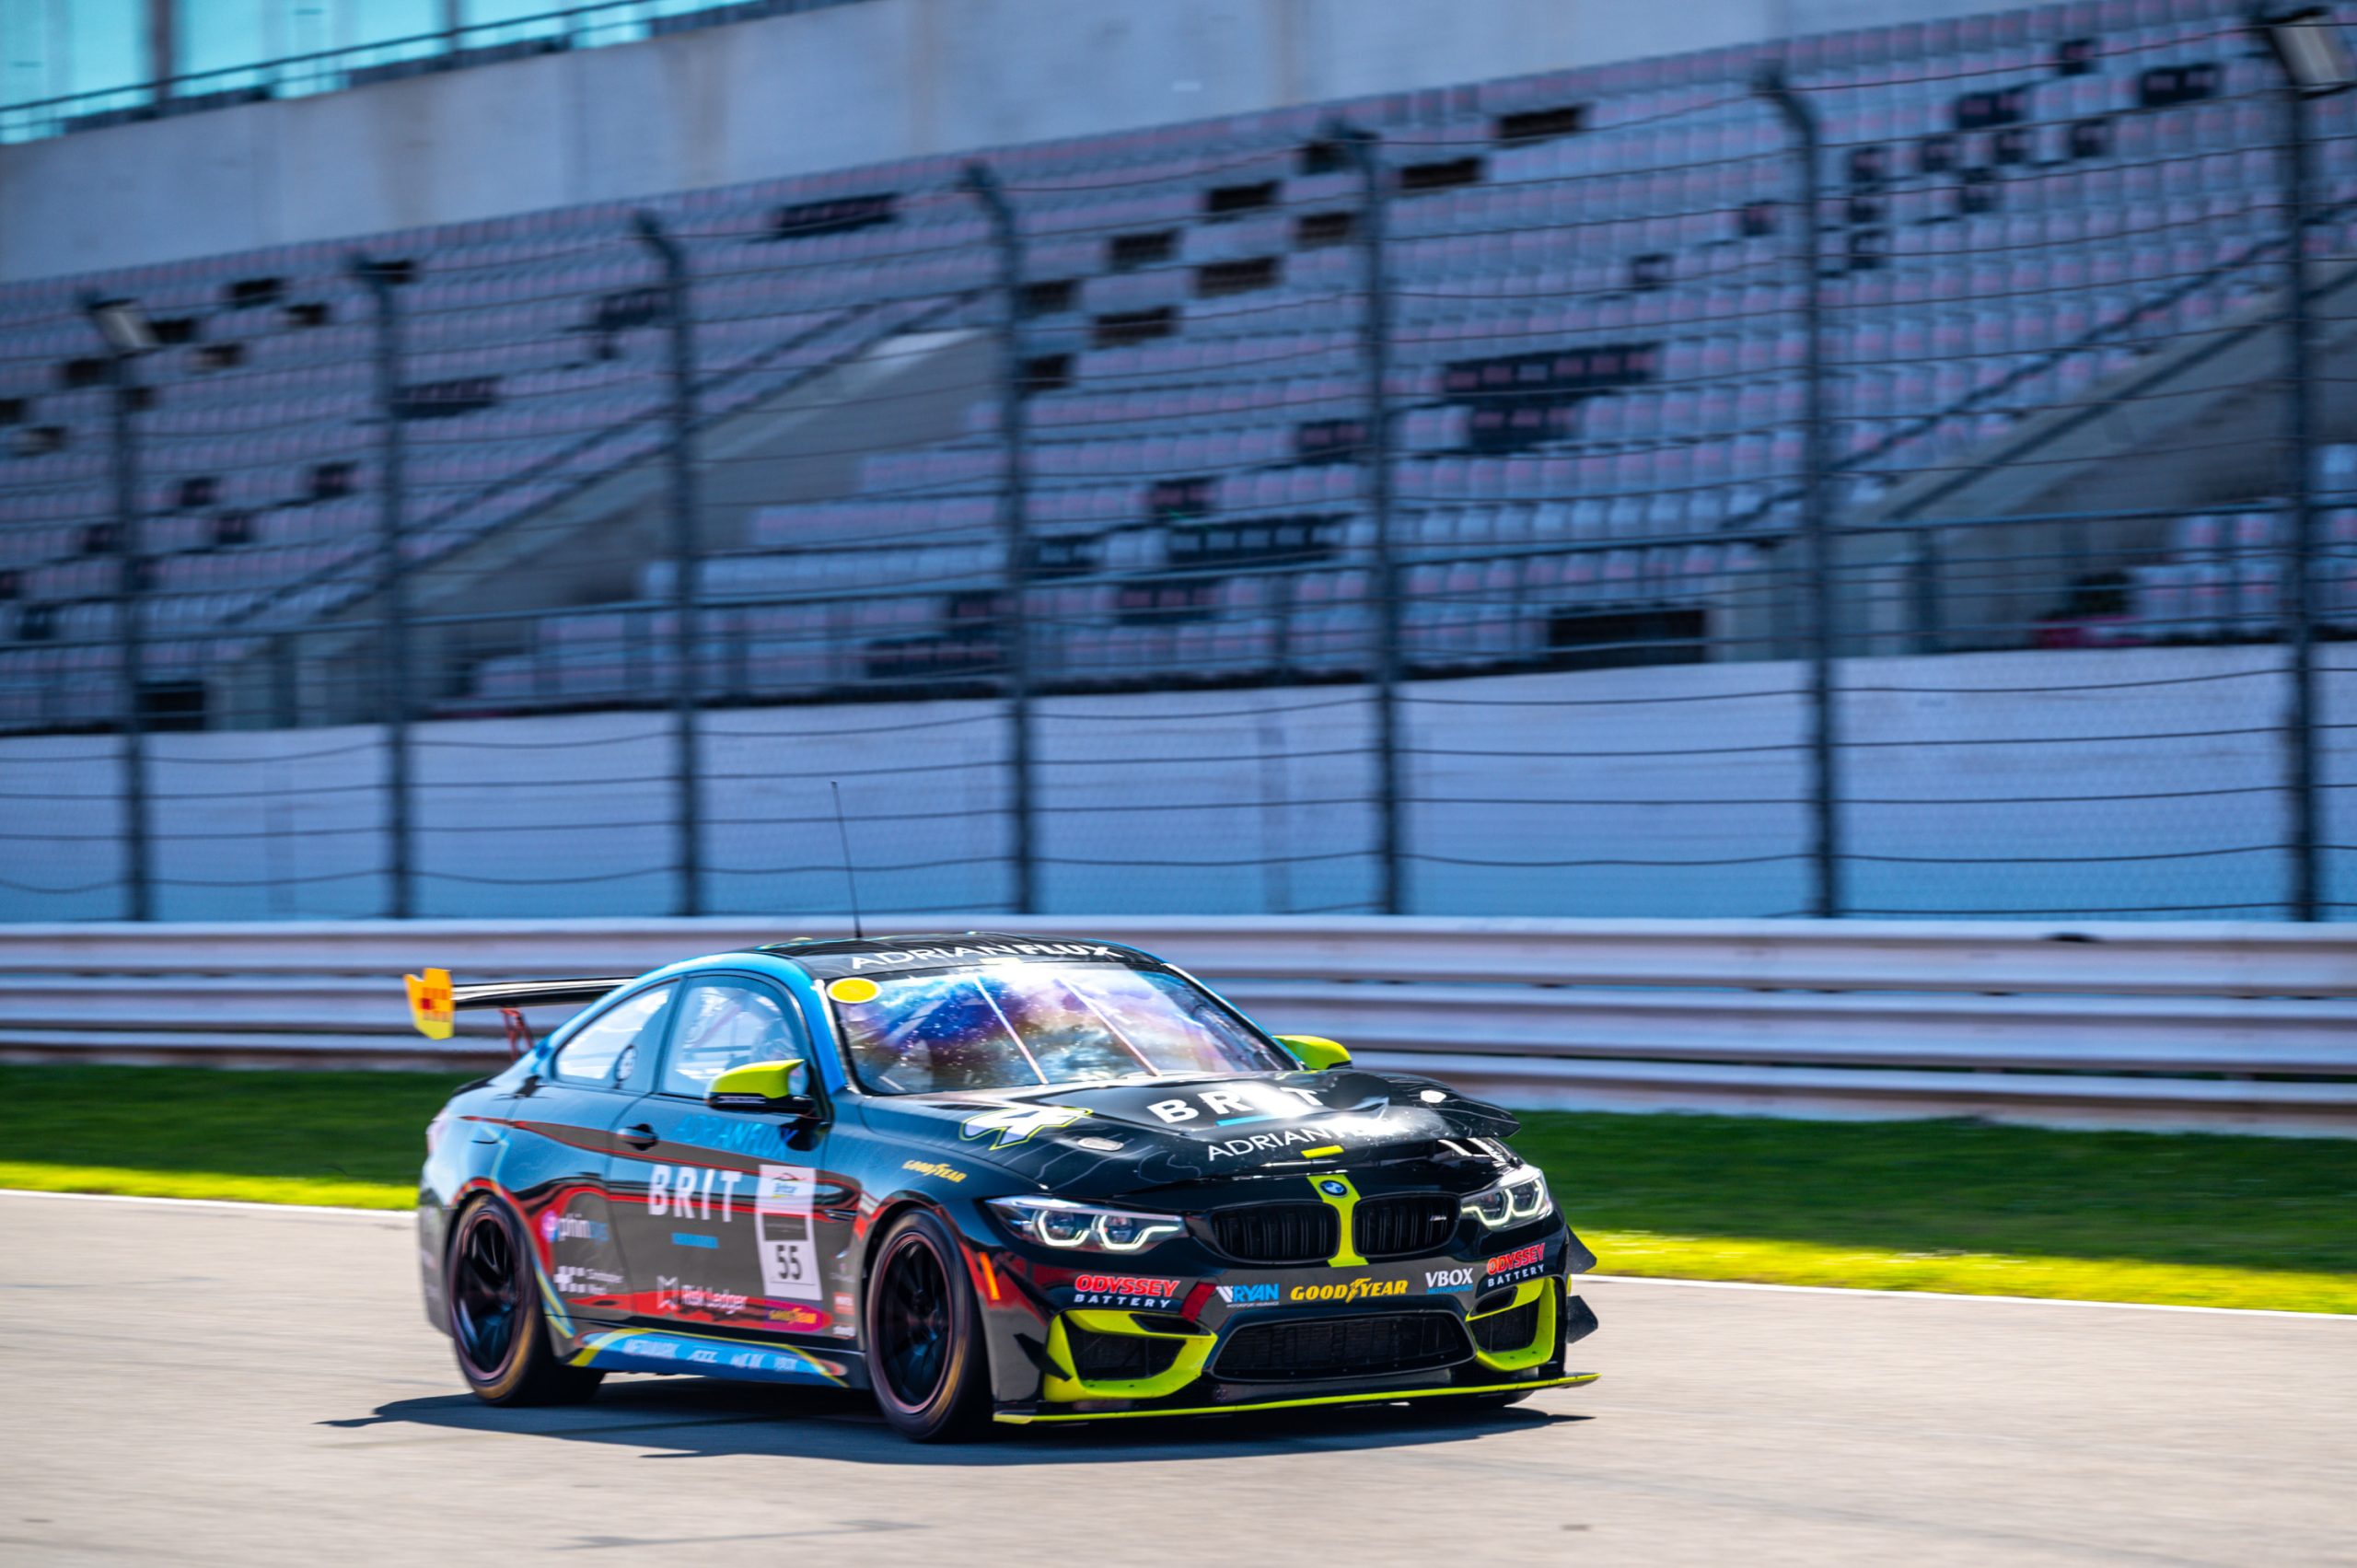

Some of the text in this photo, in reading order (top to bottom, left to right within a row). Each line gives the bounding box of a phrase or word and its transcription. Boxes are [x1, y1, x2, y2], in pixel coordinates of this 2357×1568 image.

[1147, 1086, 1324, 1124] BRT
[647, 1164, 743, 1223] BRIT
[775, 1244, 802, 1280] 55
[1487, 1243, 1545, 1275] ODYSSEY
[1074, 1274, 1180, 1297] ODYSSEY
[1425, 1267, 1473, 1288] VBOX
[1487, 1263, 1545, 1288] BATTERY
[1074, 1294, 1171, 1308] BATTERY
[1234, 1283, 1280, 1303] RYAN
[1290, 1278, 1409, 1303] GOODYEAR
